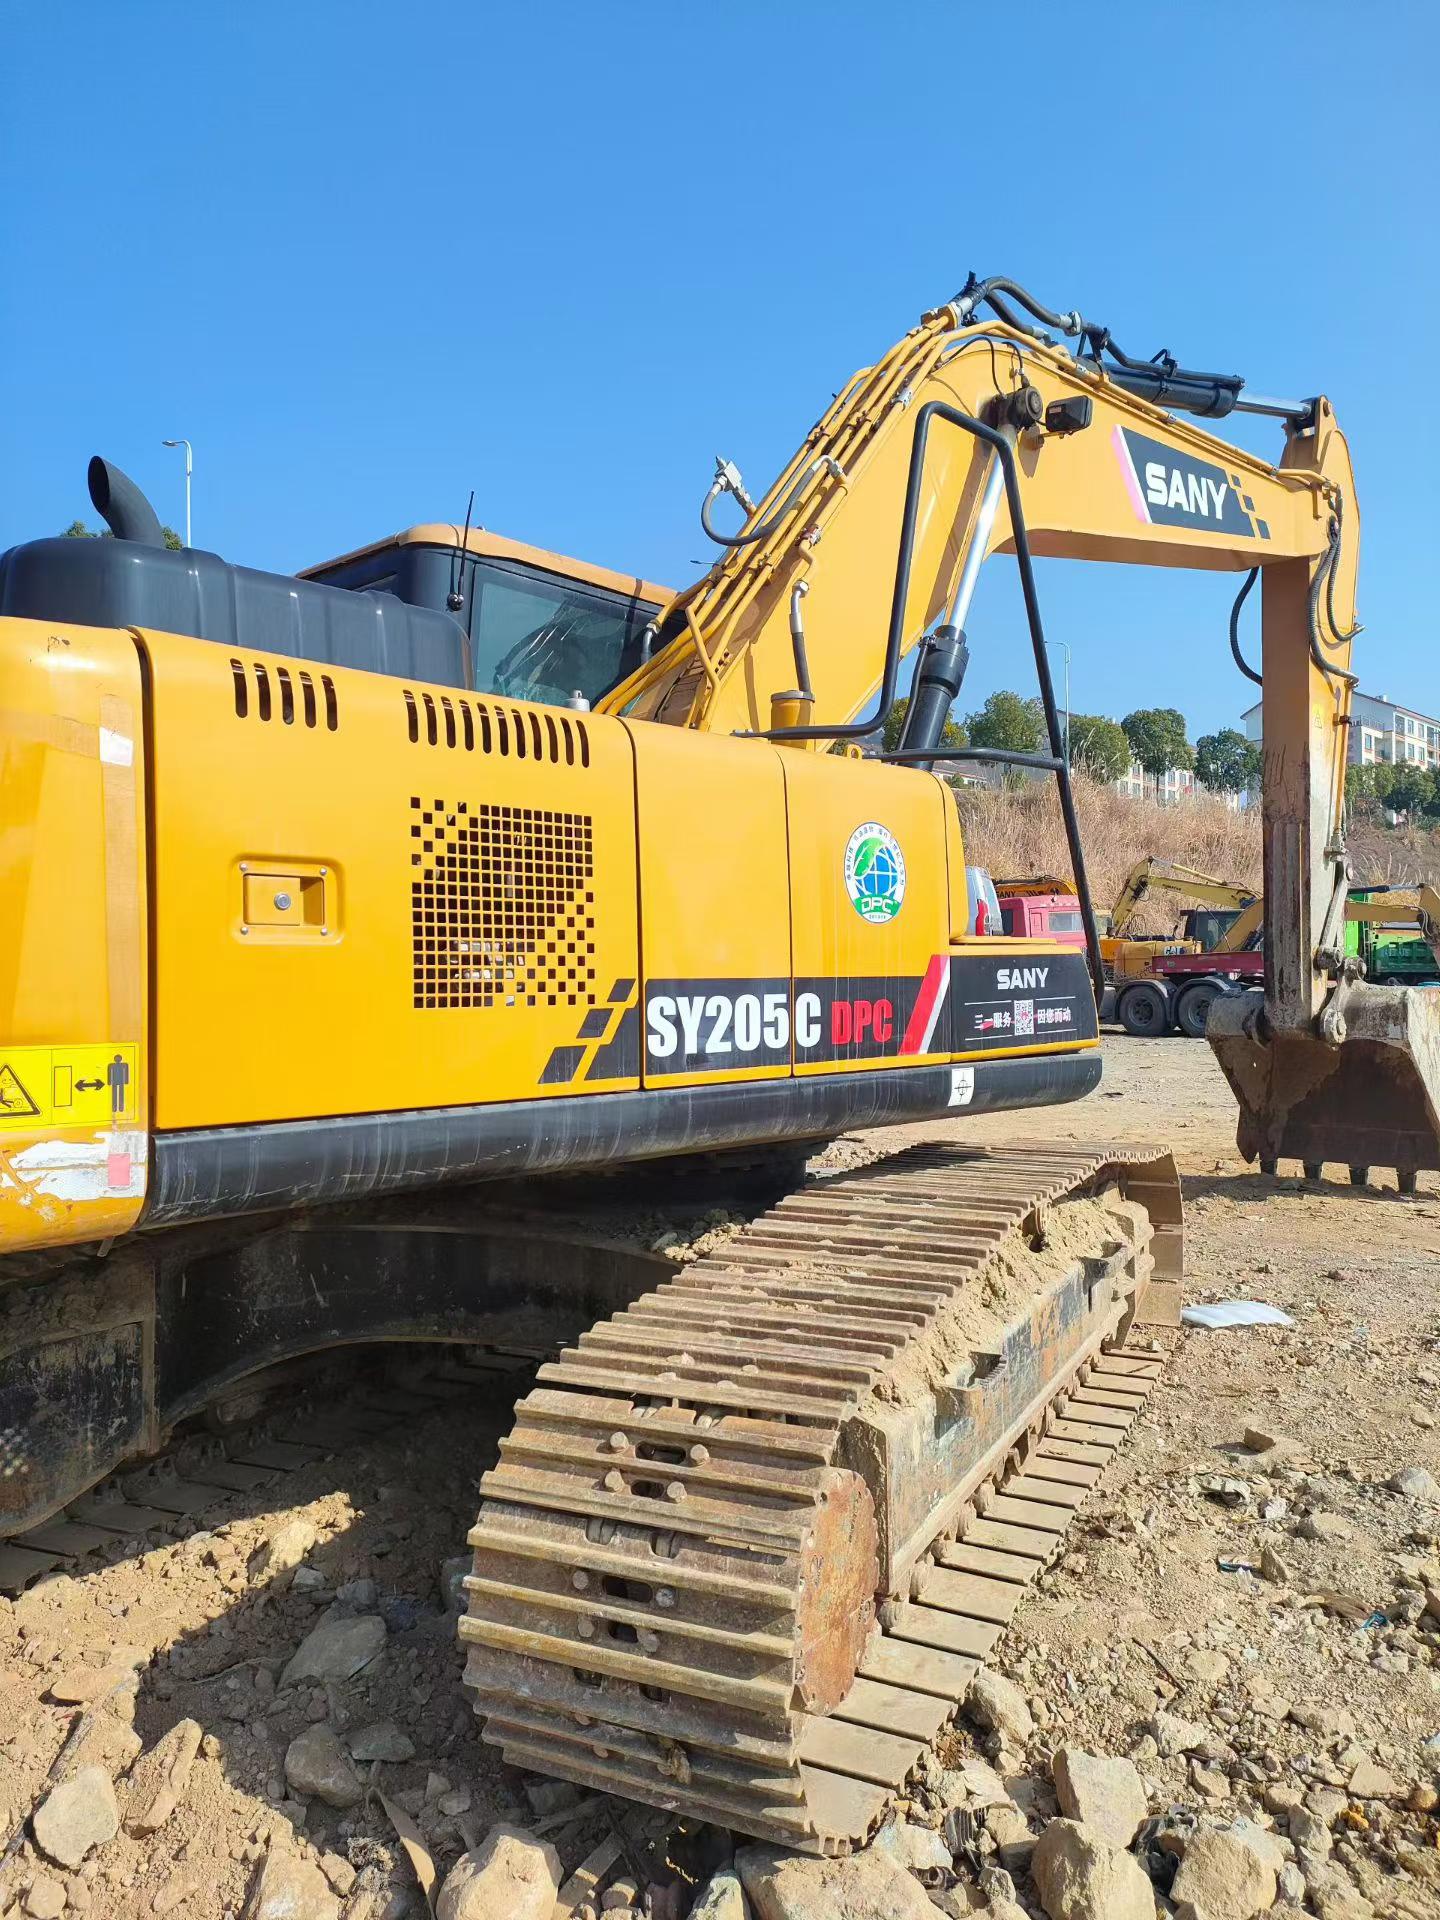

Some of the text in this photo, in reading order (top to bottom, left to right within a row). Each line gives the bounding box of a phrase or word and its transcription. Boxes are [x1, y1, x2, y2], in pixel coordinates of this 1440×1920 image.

[1145, 462, 1227, 520] SANY
[861, 896, 893, 913] DPC
[1164, 945, 1182, 956] CAT
[997, 967, 1049, 990] SANY
[646, 992, 893, 1057] SY205C DPC
[974, 1011, 1012, 1030] 三一服务
